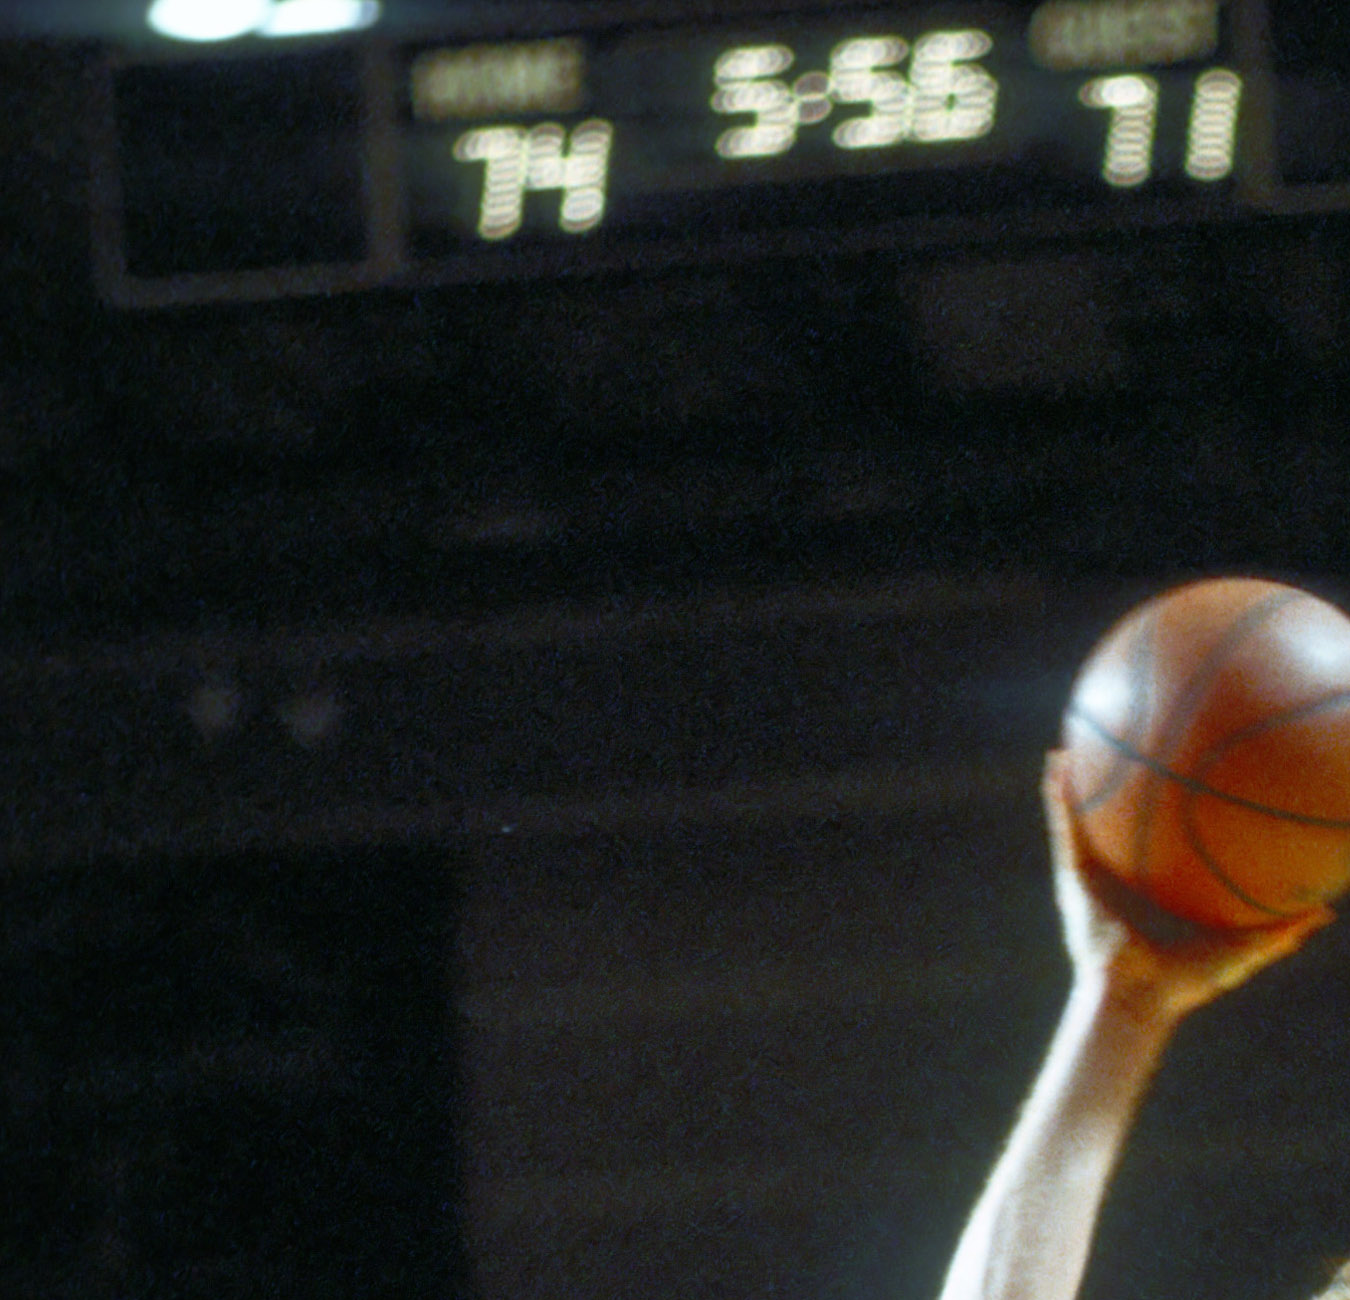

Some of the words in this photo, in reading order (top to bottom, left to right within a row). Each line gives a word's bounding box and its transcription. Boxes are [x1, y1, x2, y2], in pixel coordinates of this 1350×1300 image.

[710, 29, 998, 159] 5:56
[1078, 67, 1242, 187] 71
[453, 117, 614, 240] 74
